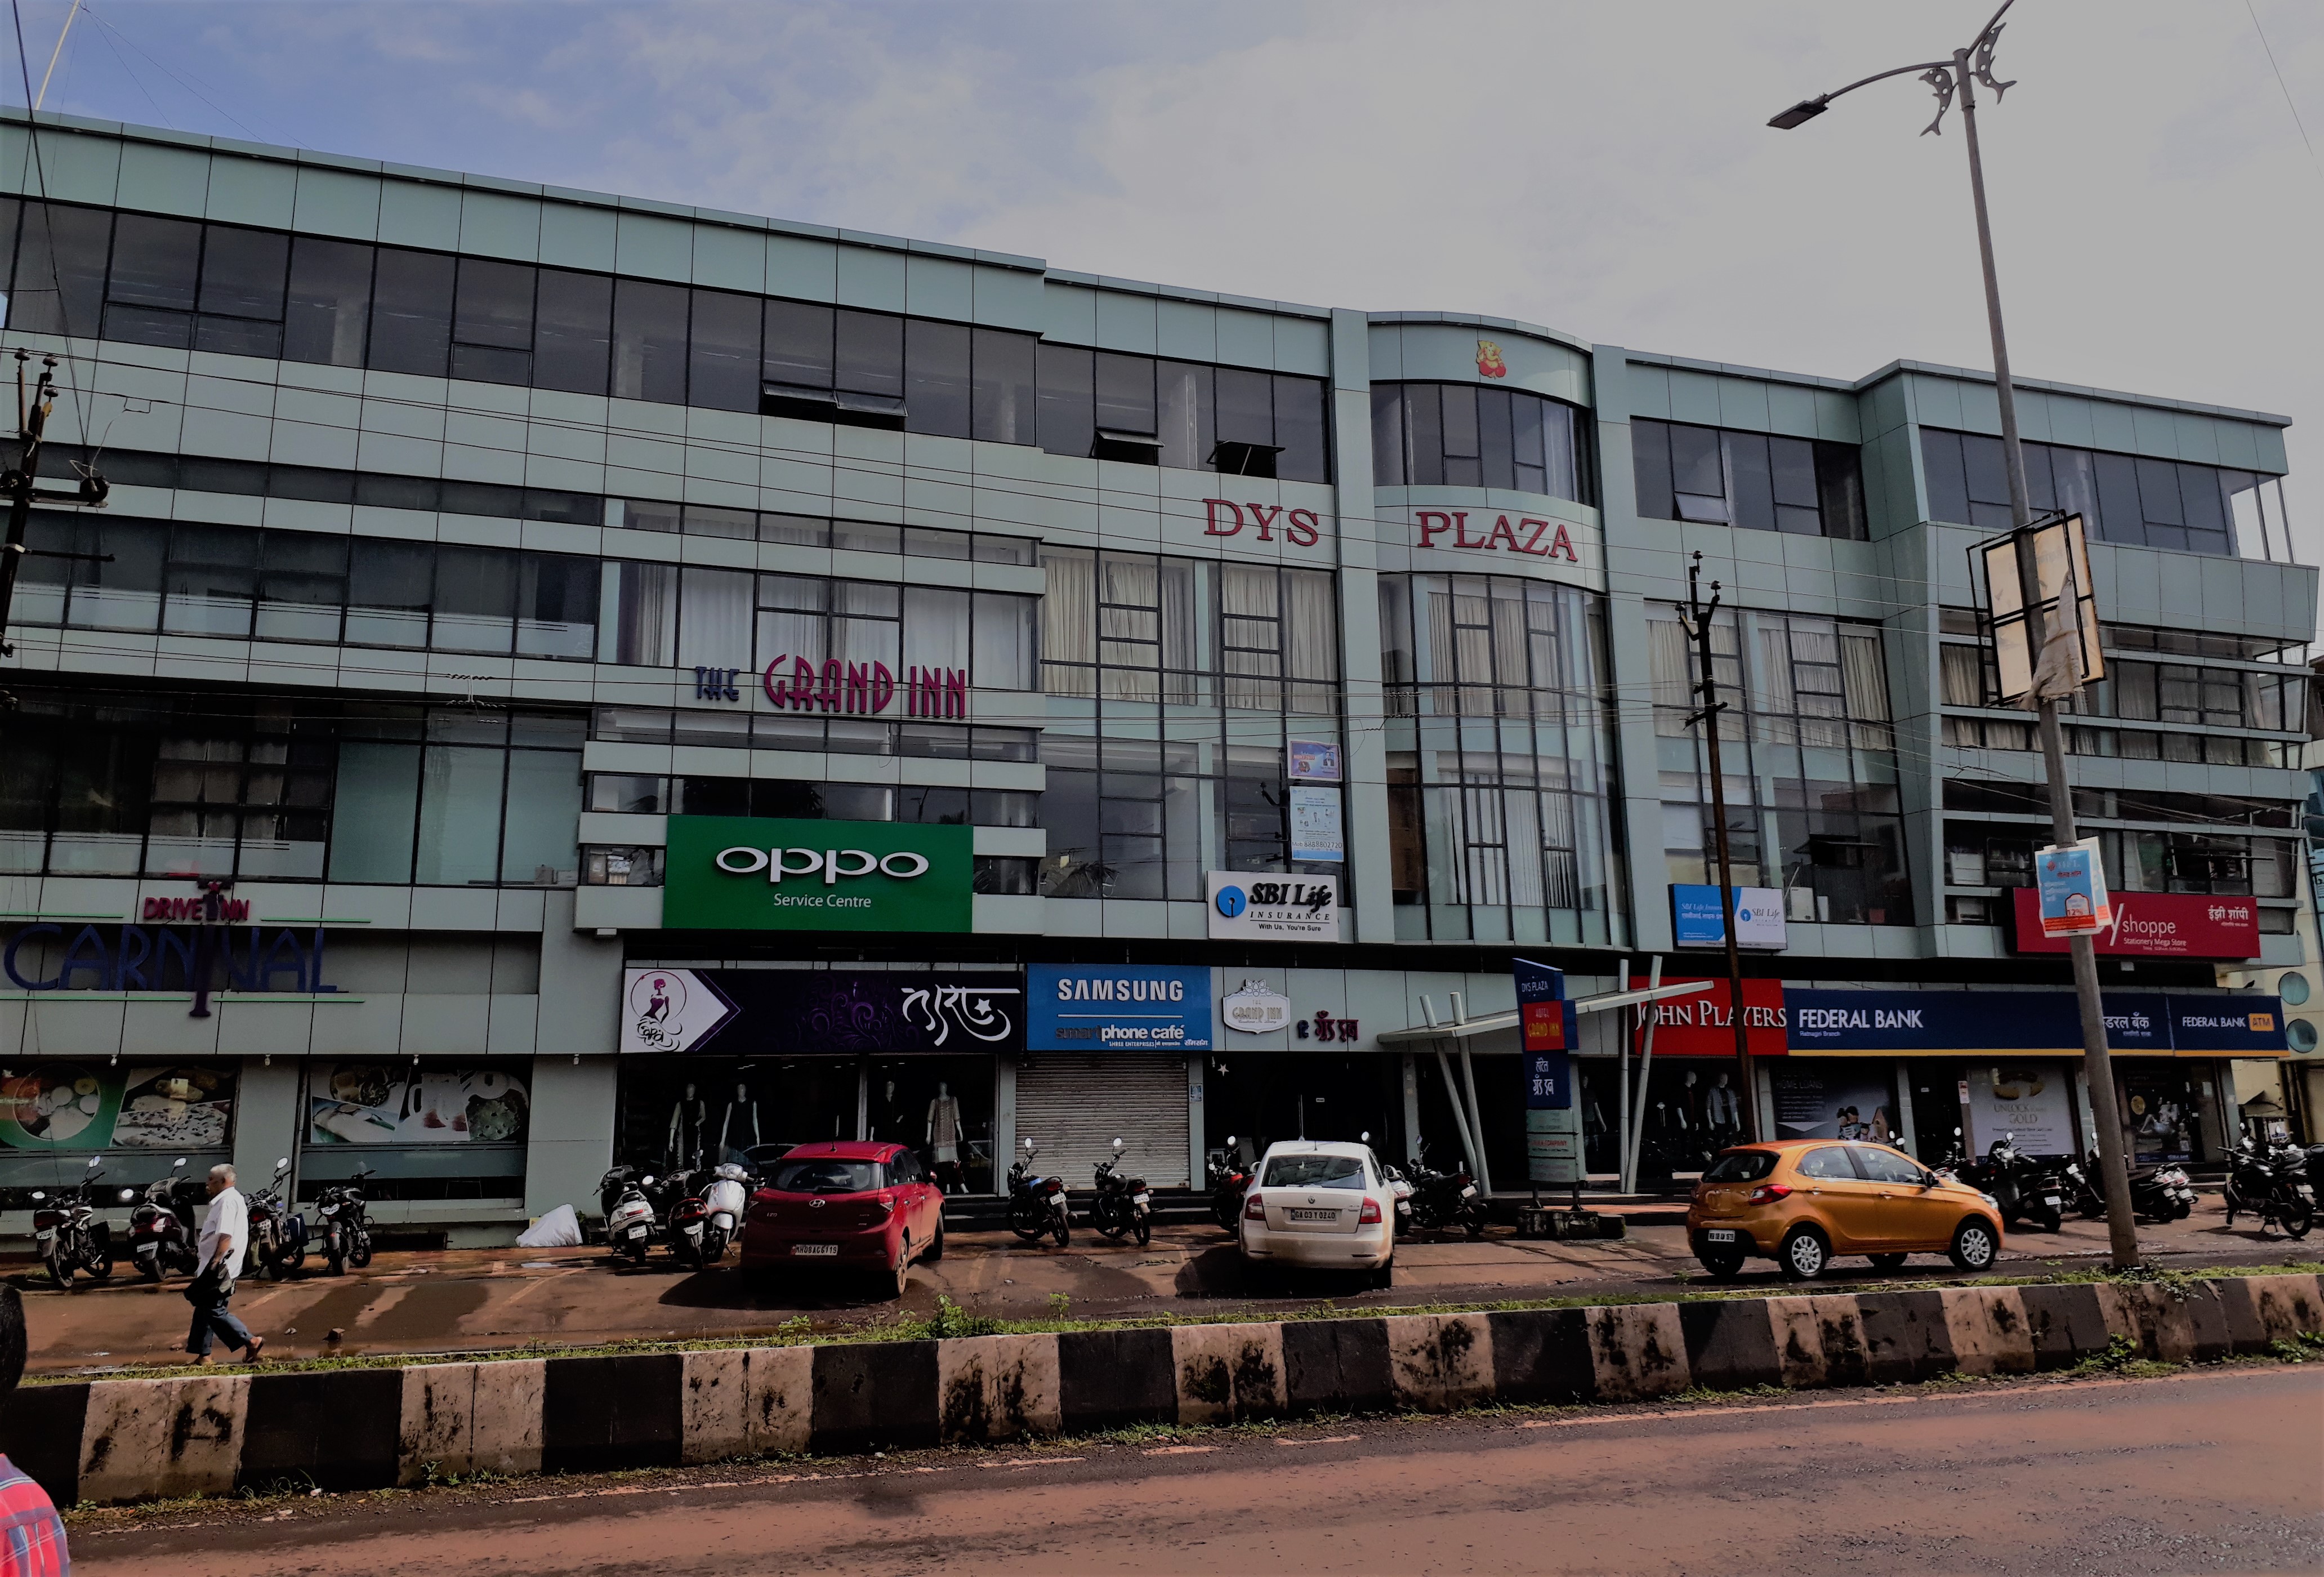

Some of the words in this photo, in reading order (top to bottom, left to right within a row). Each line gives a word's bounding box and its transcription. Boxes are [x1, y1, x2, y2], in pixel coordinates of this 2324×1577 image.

[1202, 498, 1319, 546] DYS
[1416, 511, 1578, 562] PLAZA
[694, 666, 739, 702] THE
[764, 653, 894, 714] GRAND
[909, 666, 966, 719] INN
[774, 892, 823, 908] Service
[826, 894, 872, 908] Centre
[1250, 883, 1292, 906] SBI
[1292, 884, 1332, 913] Life
[143, 897, 203, 921] DRIVE
[1250, 911, 1331, 921] INSURANCE
[1751, 907, 1765, 917] SBI
[1767, 908, 1781, 919] Life
[2124, 937, 2153, 947] Stationery
[2153, 938, 2170, 947] Mega
[2171, 938, 2187, 947] Store
[1057, 978, 1183, 1002] SAMSUNG
[1232, 1007, 1264, 1020] GRAND
[1799, 1009, 1870, 1030] FEDERAL
[1875, 1009, 1924, 1030] BANK
[2182, 1016, 2219, 1028] FEDERAL
[2220, 1017, 2246, 1028] BANK
[1150, 1024, 1185, 1040] café
[1994, 1104, 2030, 1112] UNLOCK
[2009, 1113, 2037, 1124] GOLD
